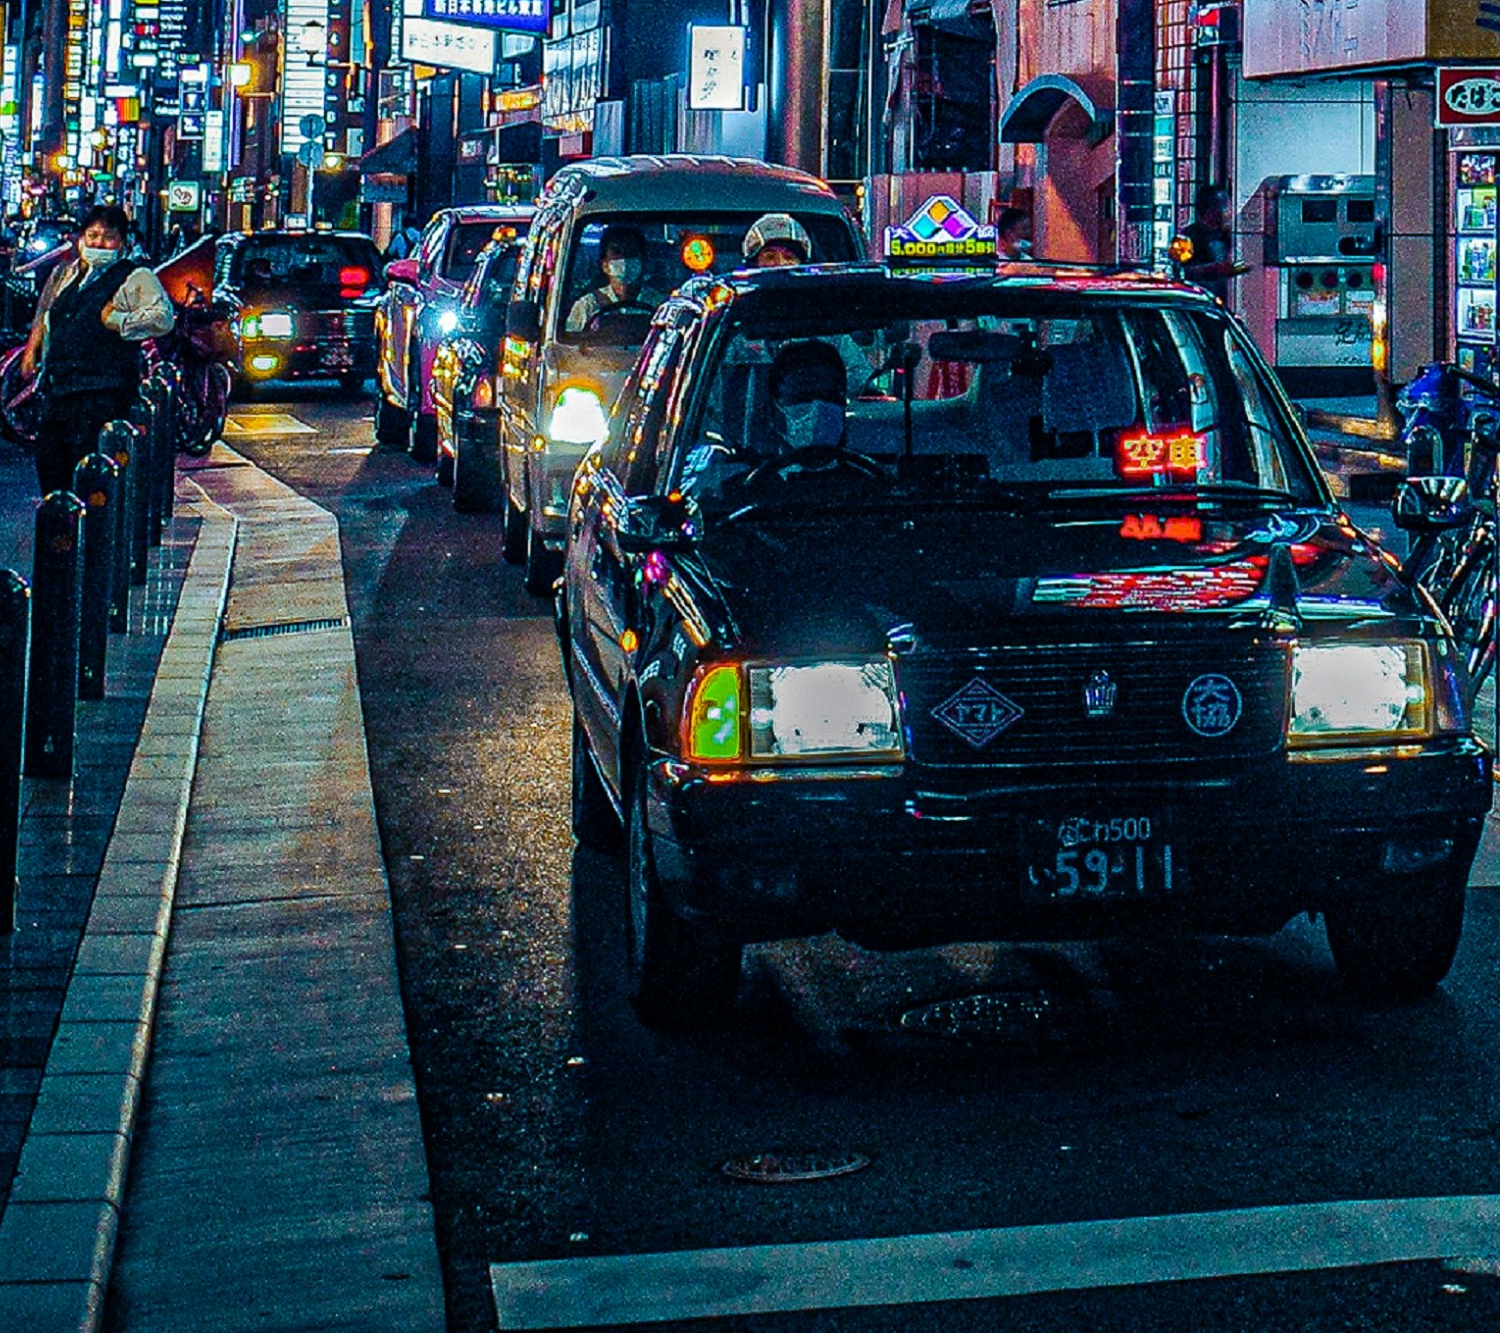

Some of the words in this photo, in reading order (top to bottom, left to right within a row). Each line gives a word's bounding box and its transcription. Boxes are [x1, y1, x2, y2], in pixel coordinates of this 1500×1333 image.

[1123, 434, 1206, 471] 空車
[1110, 818, 1150, 841] 500
[1056, 845, 1172, 896] 59-11
